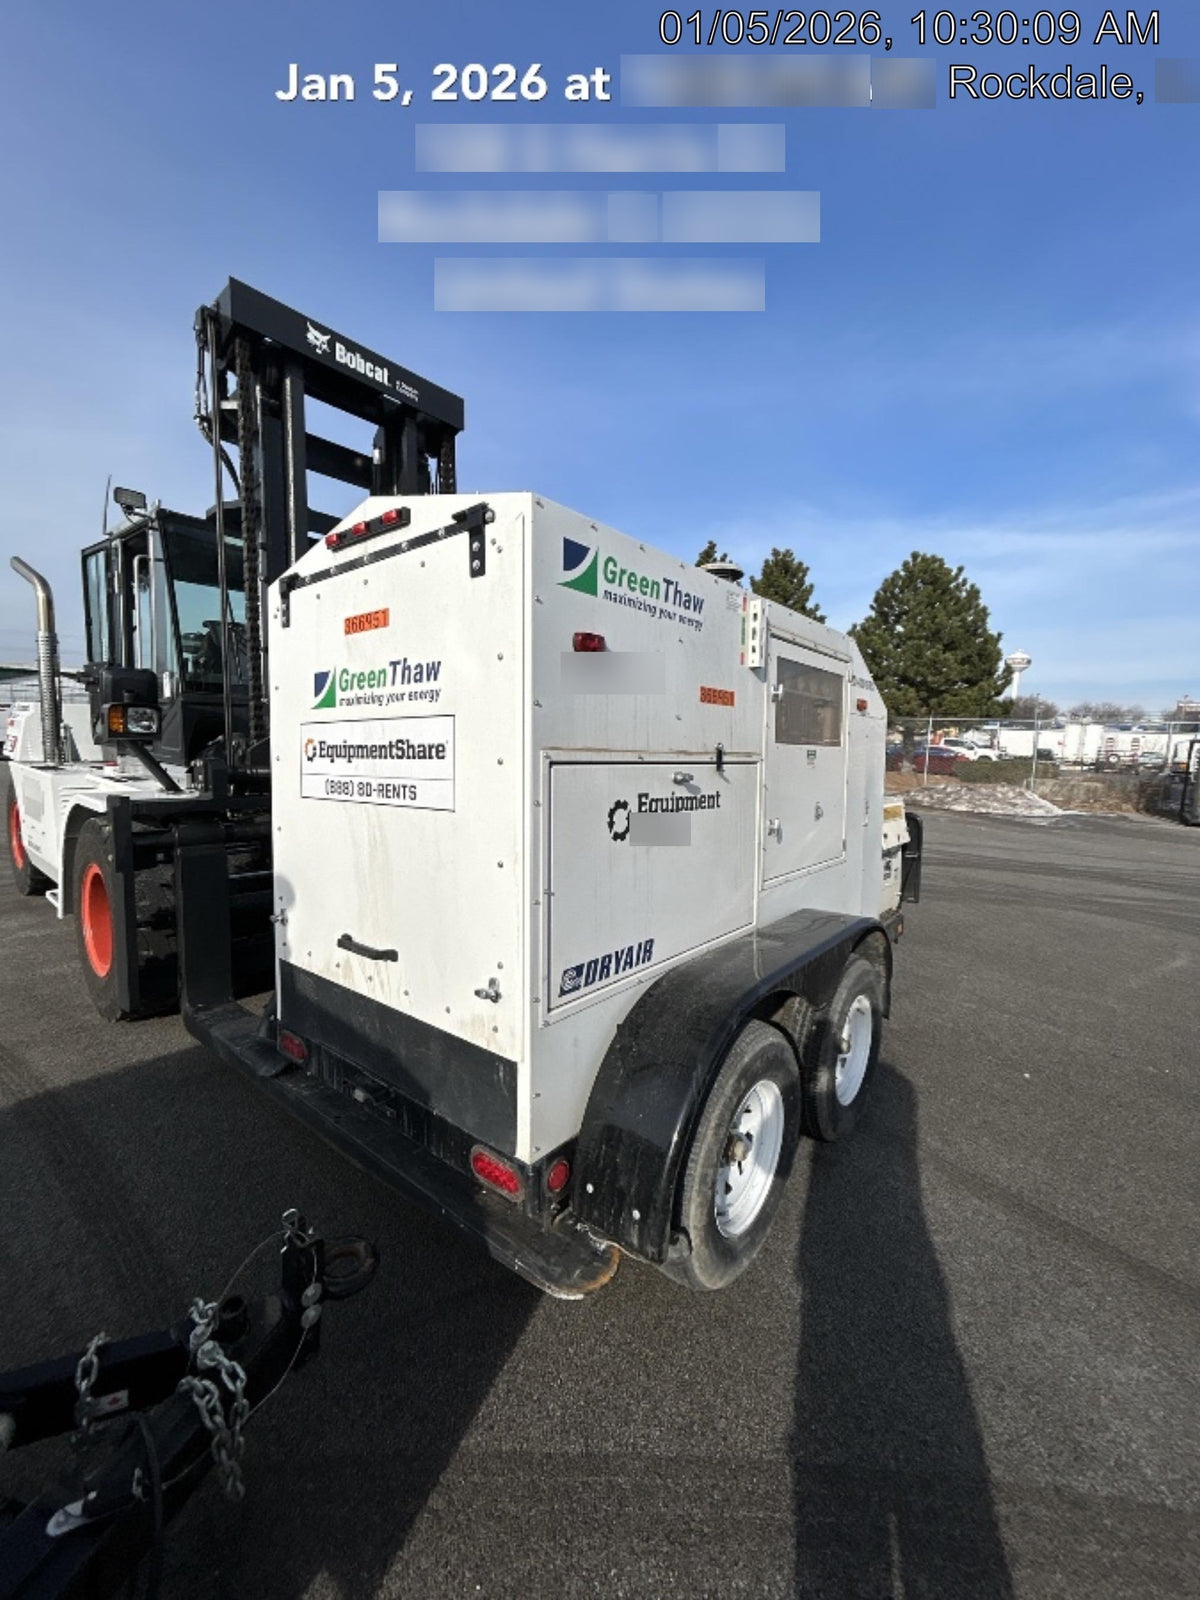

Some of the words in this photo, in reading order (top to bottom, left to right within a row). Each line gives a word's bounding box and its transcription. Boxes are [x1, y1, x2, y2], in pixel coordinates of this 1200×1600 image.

[335, 341, 389, 386] Bobcat
[603, 556, 705, 615] GreenThaw
[603, 589, 657, 620] maximizing
[658, 607, 677, 622] your
[339, 657, 442, 692] GreenThaw
[338, 693, 384, 707] maximizing
[385, 691, 405, 705] your
[408, 688, 441, 704] energy
[318, 739, 447, 763] EquipmentShare
[325, 778, 354, 797] (888)
[637, 791, 721, 813] Equipment
[583, 938, 655, 988] DRYAIR
